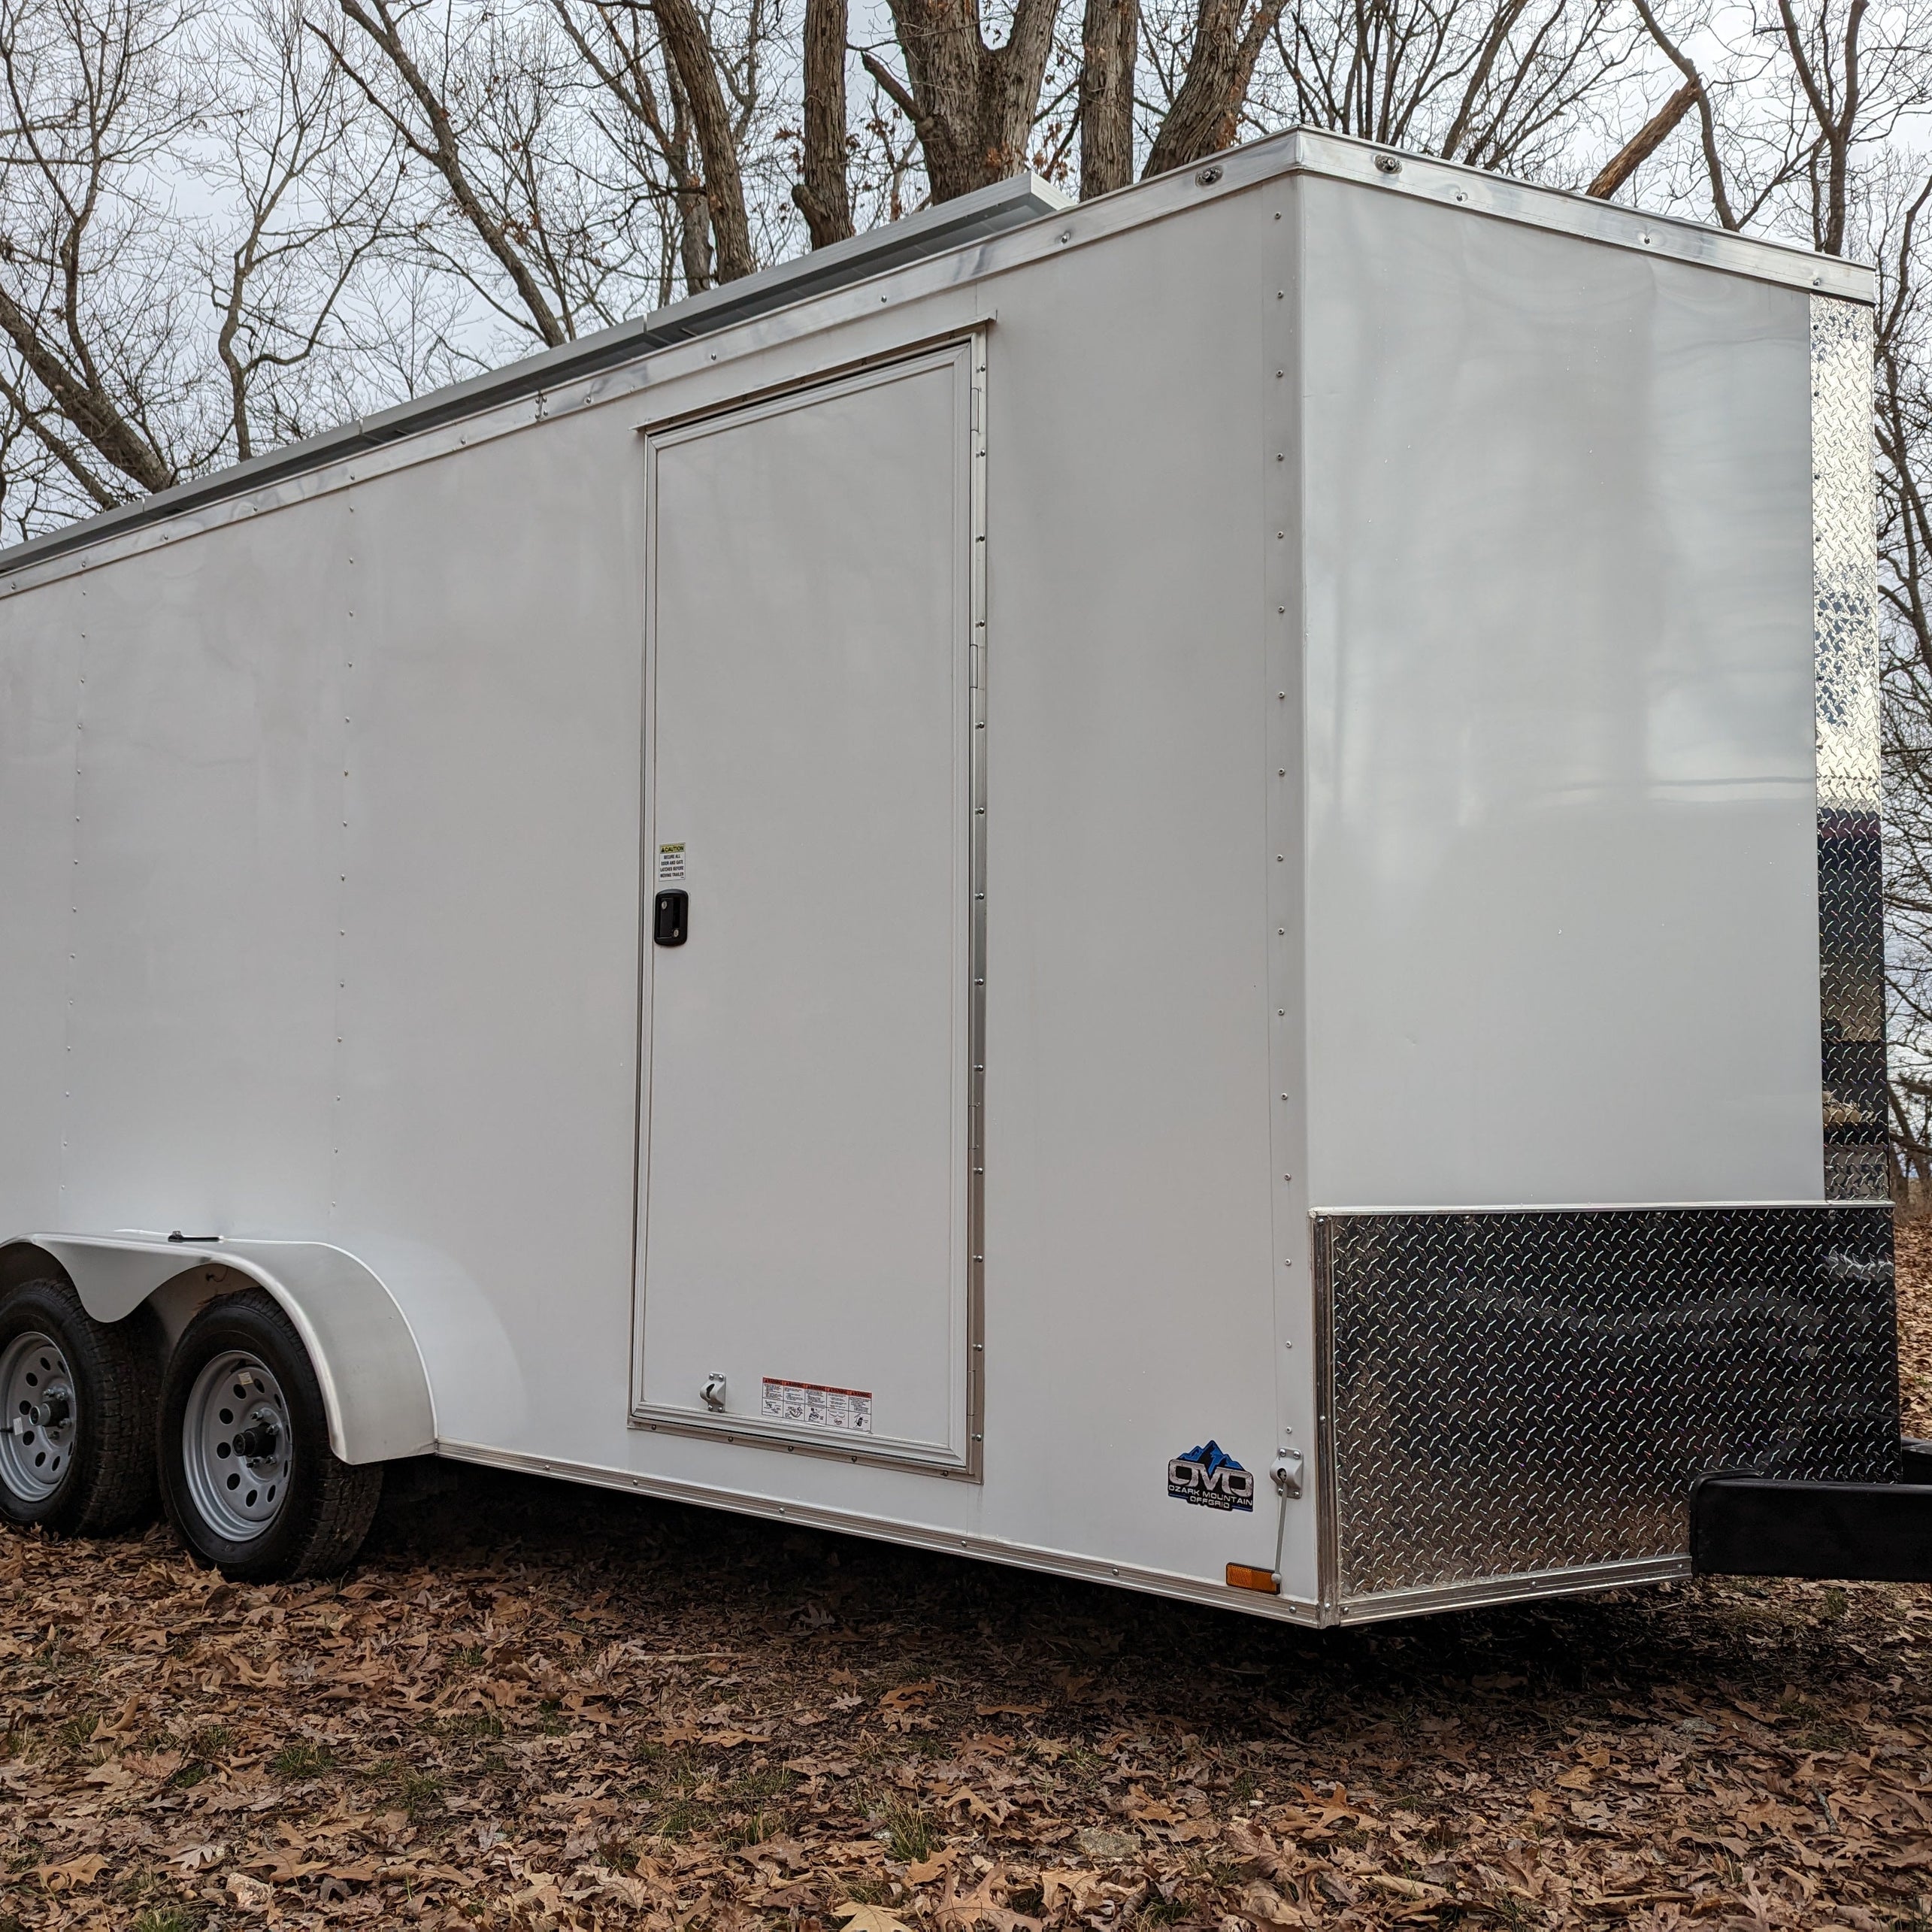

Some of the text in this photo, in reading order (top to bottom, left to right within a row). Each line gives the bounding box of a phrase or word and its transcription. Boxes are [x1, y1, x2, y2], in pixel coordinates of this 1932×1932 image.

[1168, 1485, 1253, 1506] OZARK MOUNTAIN
[1189, 1496, 1230, 1509] OFFGRID
